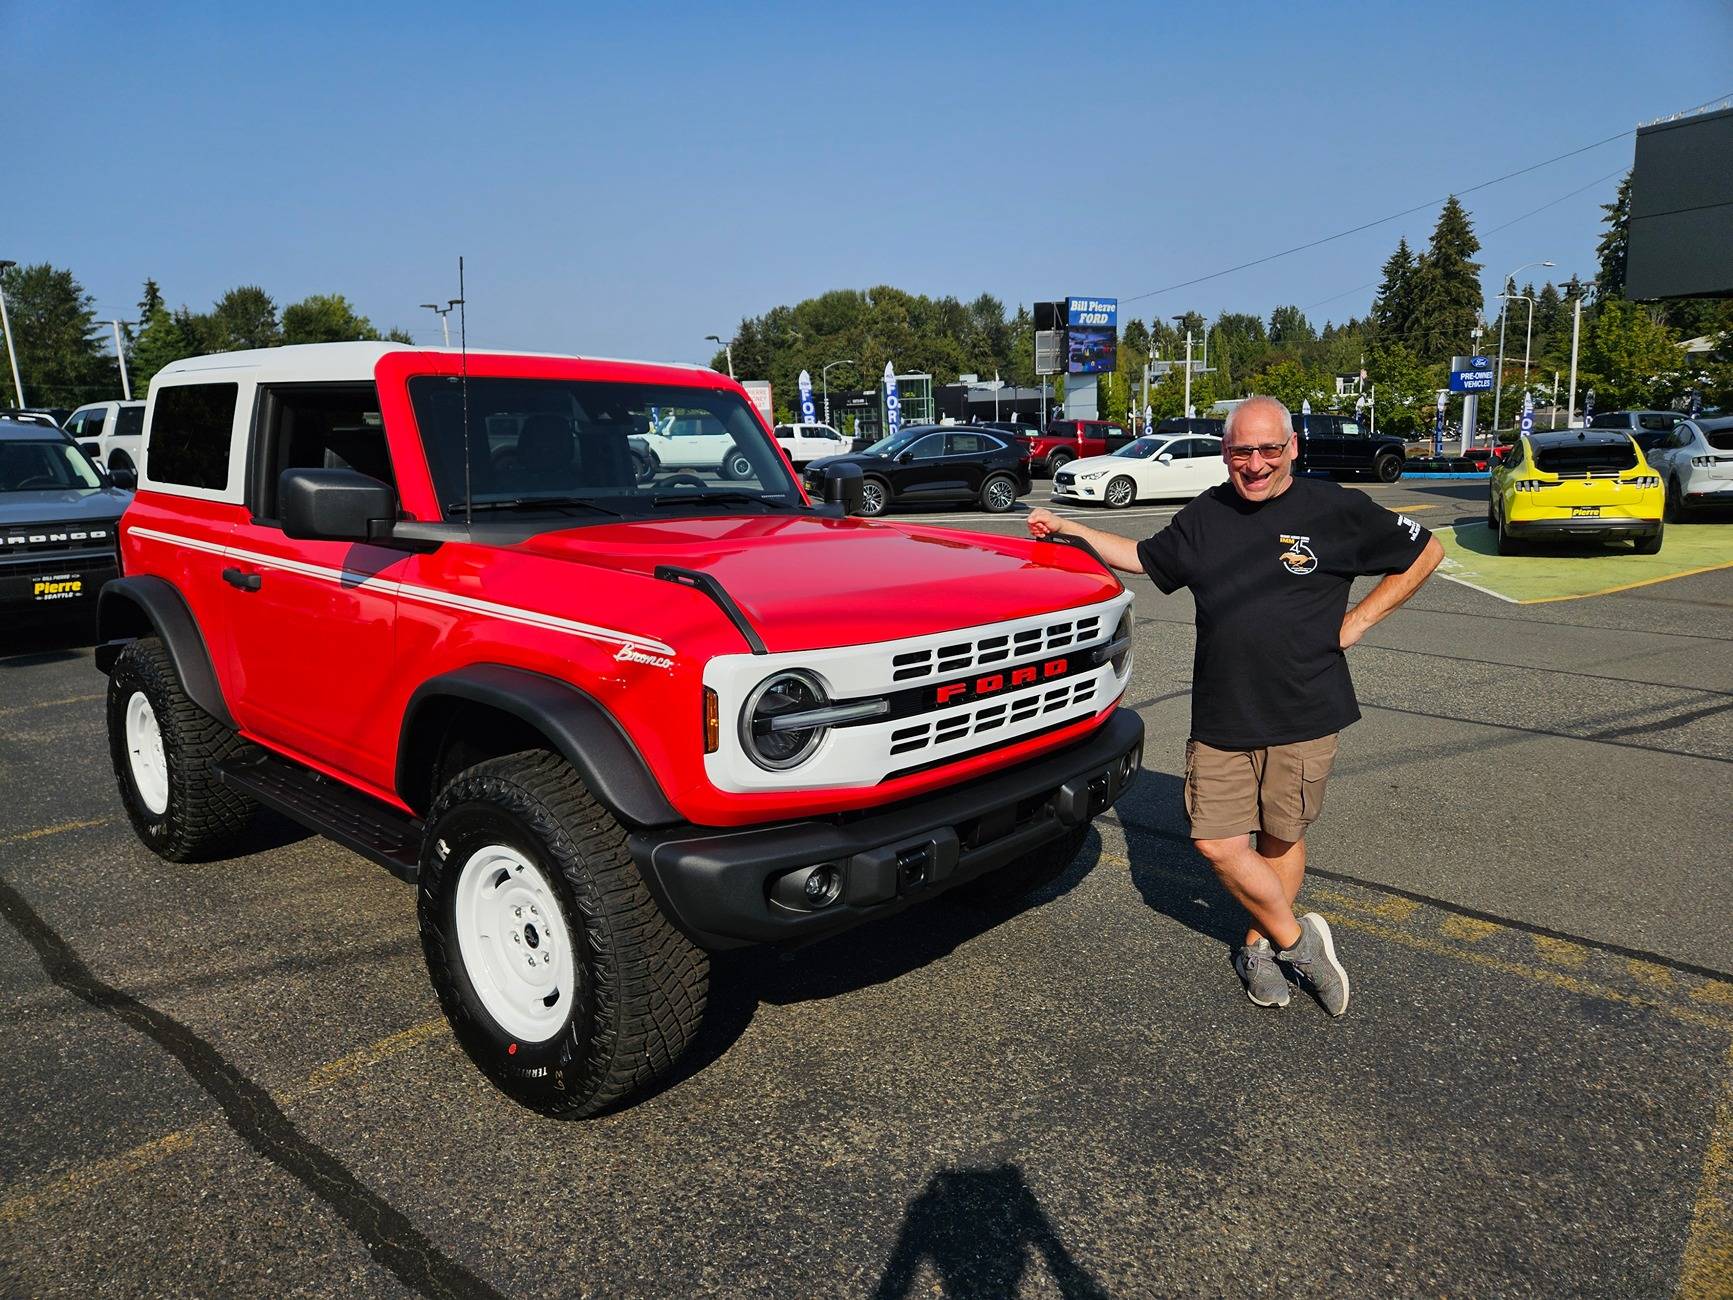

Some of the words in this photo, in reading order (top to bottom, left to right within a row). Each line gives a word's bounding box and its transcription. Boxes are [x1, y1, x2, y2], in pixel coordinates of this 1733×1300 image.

[1071, 301, 1088, 312] Bill
[1089, 301, 1116, 313] Pierre
[1079, 313, 1109, 325] FORD
[1460, 371, 1493, 381] PRE-OWNED
[1464, 379, 1491, 389] VEHICLES
[886, 382, 899, 436] FORD
[1572, 508, 1600, 516] Pierre
[0, 530, 107, 545] RONCO
[34, 581, 82, 595] Pierre
[44, 592, 74, 600] SEATTLE
[613, 641, 675, 669] Bronco
[936, 658, 1069, 704] FORD
